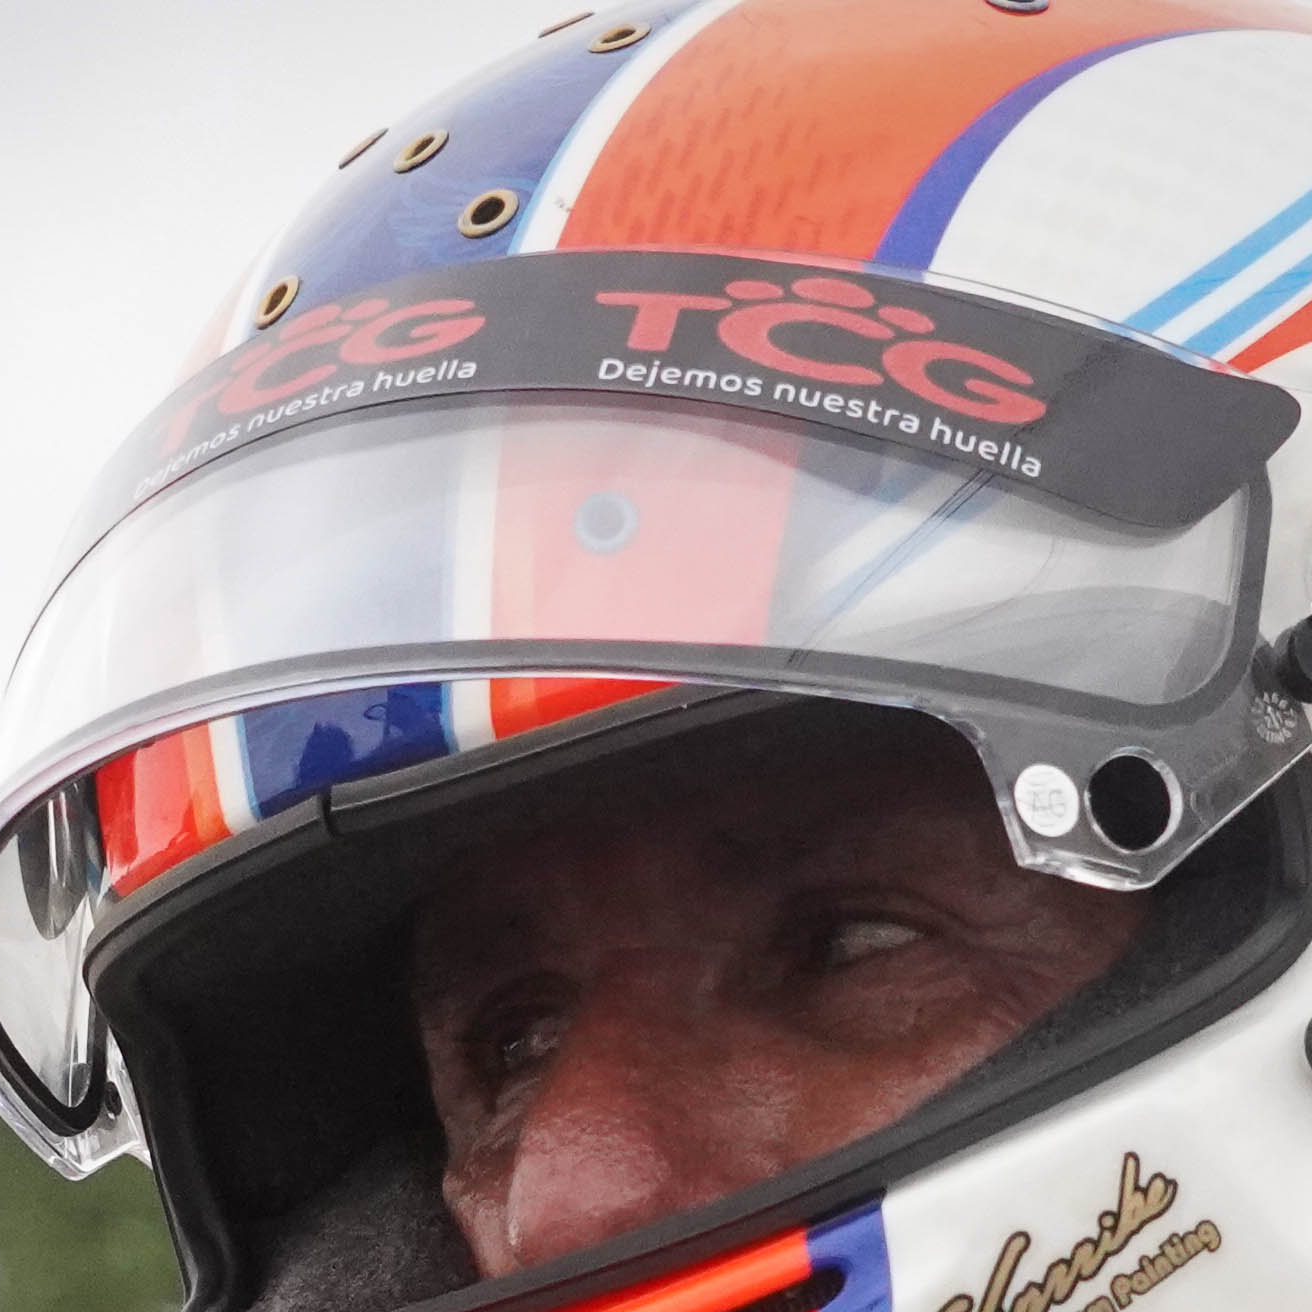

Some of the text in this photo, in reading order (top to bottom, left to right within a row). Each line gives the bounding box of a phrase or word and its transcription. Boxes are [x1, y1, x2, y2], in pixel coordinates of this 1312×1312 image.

[152, 299, 486, 458] TCG
[247, 379, 365, 431] nuestra
[372, 358, 478, 391] huella
[595, 290, 1047, 424] TCG
[597, 357, 1043, 478] Dejemos nuestra huella
[1110, 1219, 1222, 1310] Painting
